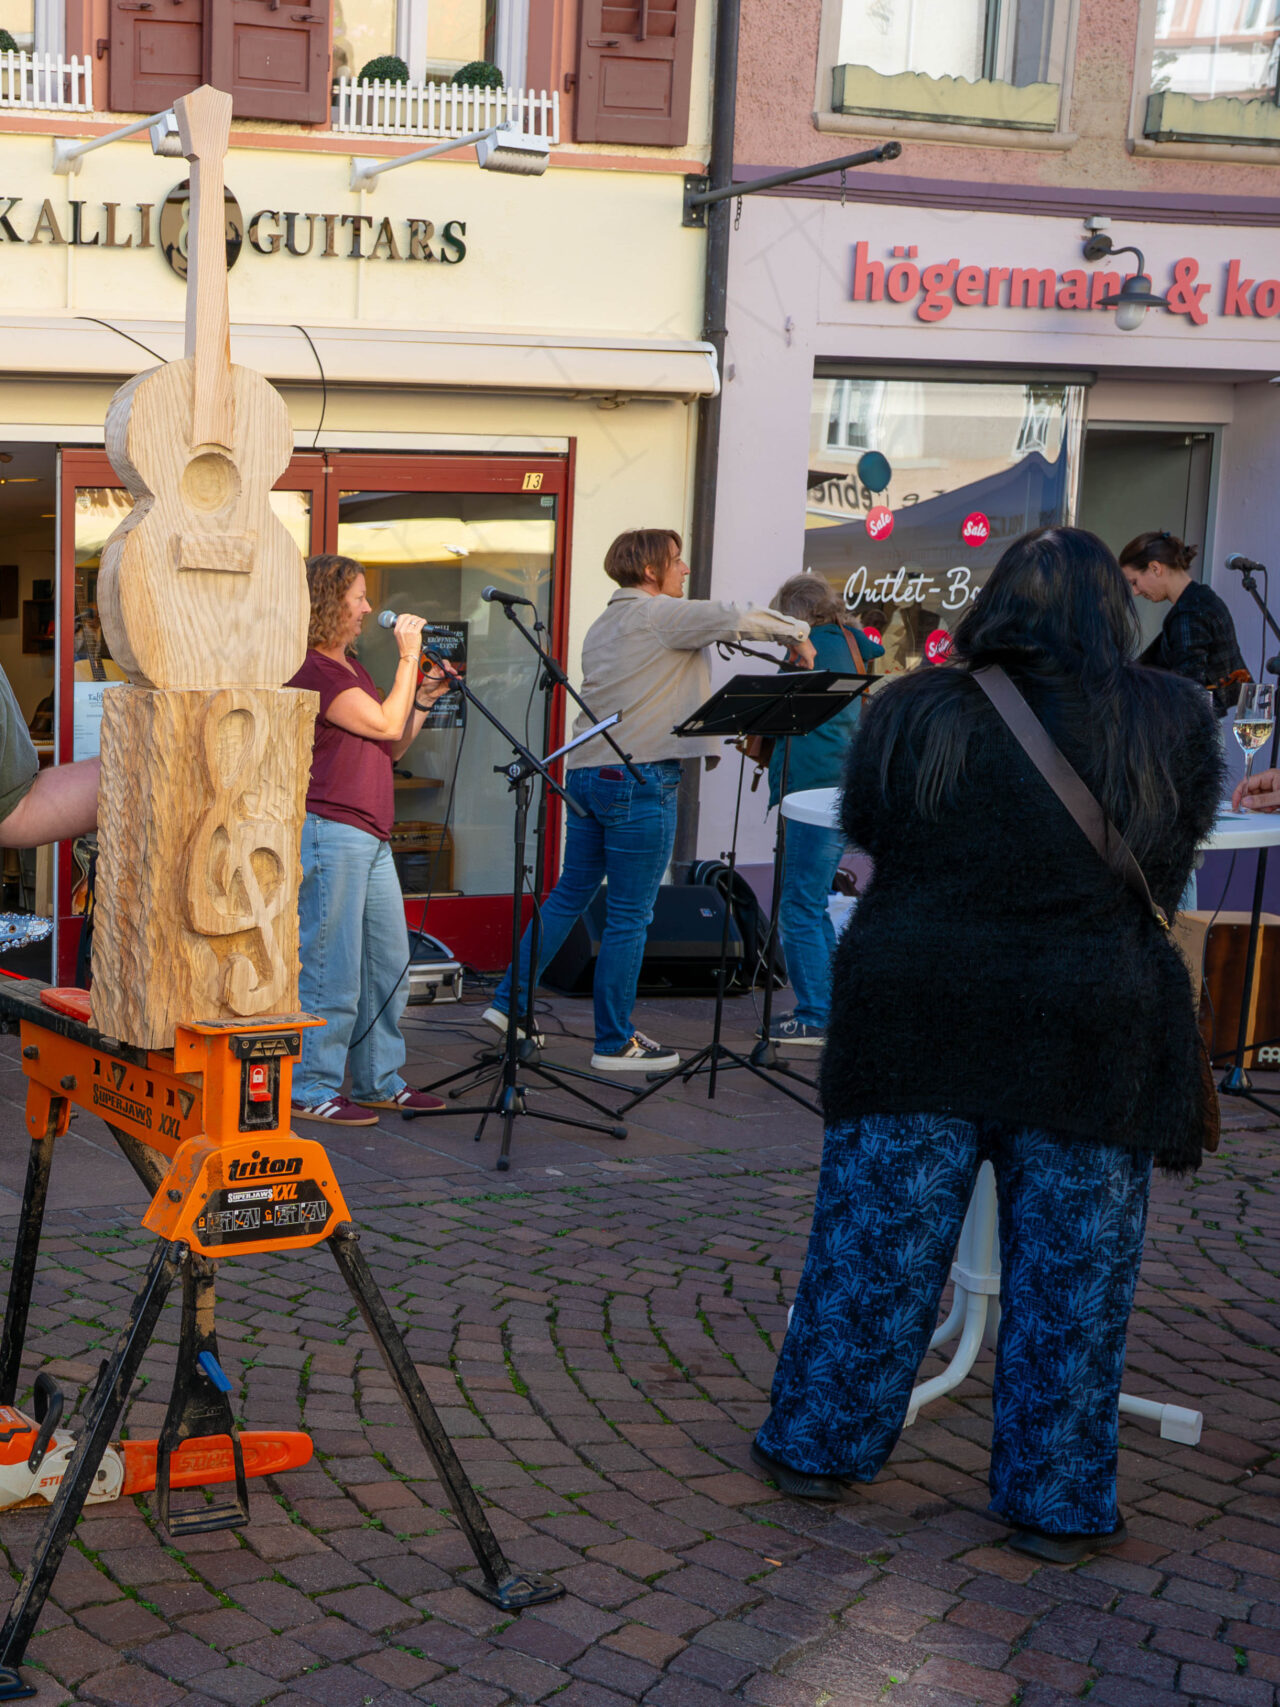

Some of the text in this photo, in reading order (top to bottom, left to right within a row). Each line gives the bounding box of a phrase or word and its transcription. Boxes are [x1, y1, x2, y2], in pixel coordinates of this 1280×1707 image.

[248, 209, 468, 265] GUITARS
[1165, 257, 1212, 325] &
[525, 474, 542, 489] 13
[870, 512, 892, 537] Sale
[963, 521, 988, 538] Sale
[93, 1083, 182, 1141] SUPERJAWS XXL
[228, 1150, 303, 1181] triton
[227, 1182, 299, 1203] SUPERJAWS XXL
[39, 1474, 65, 1488] STI
